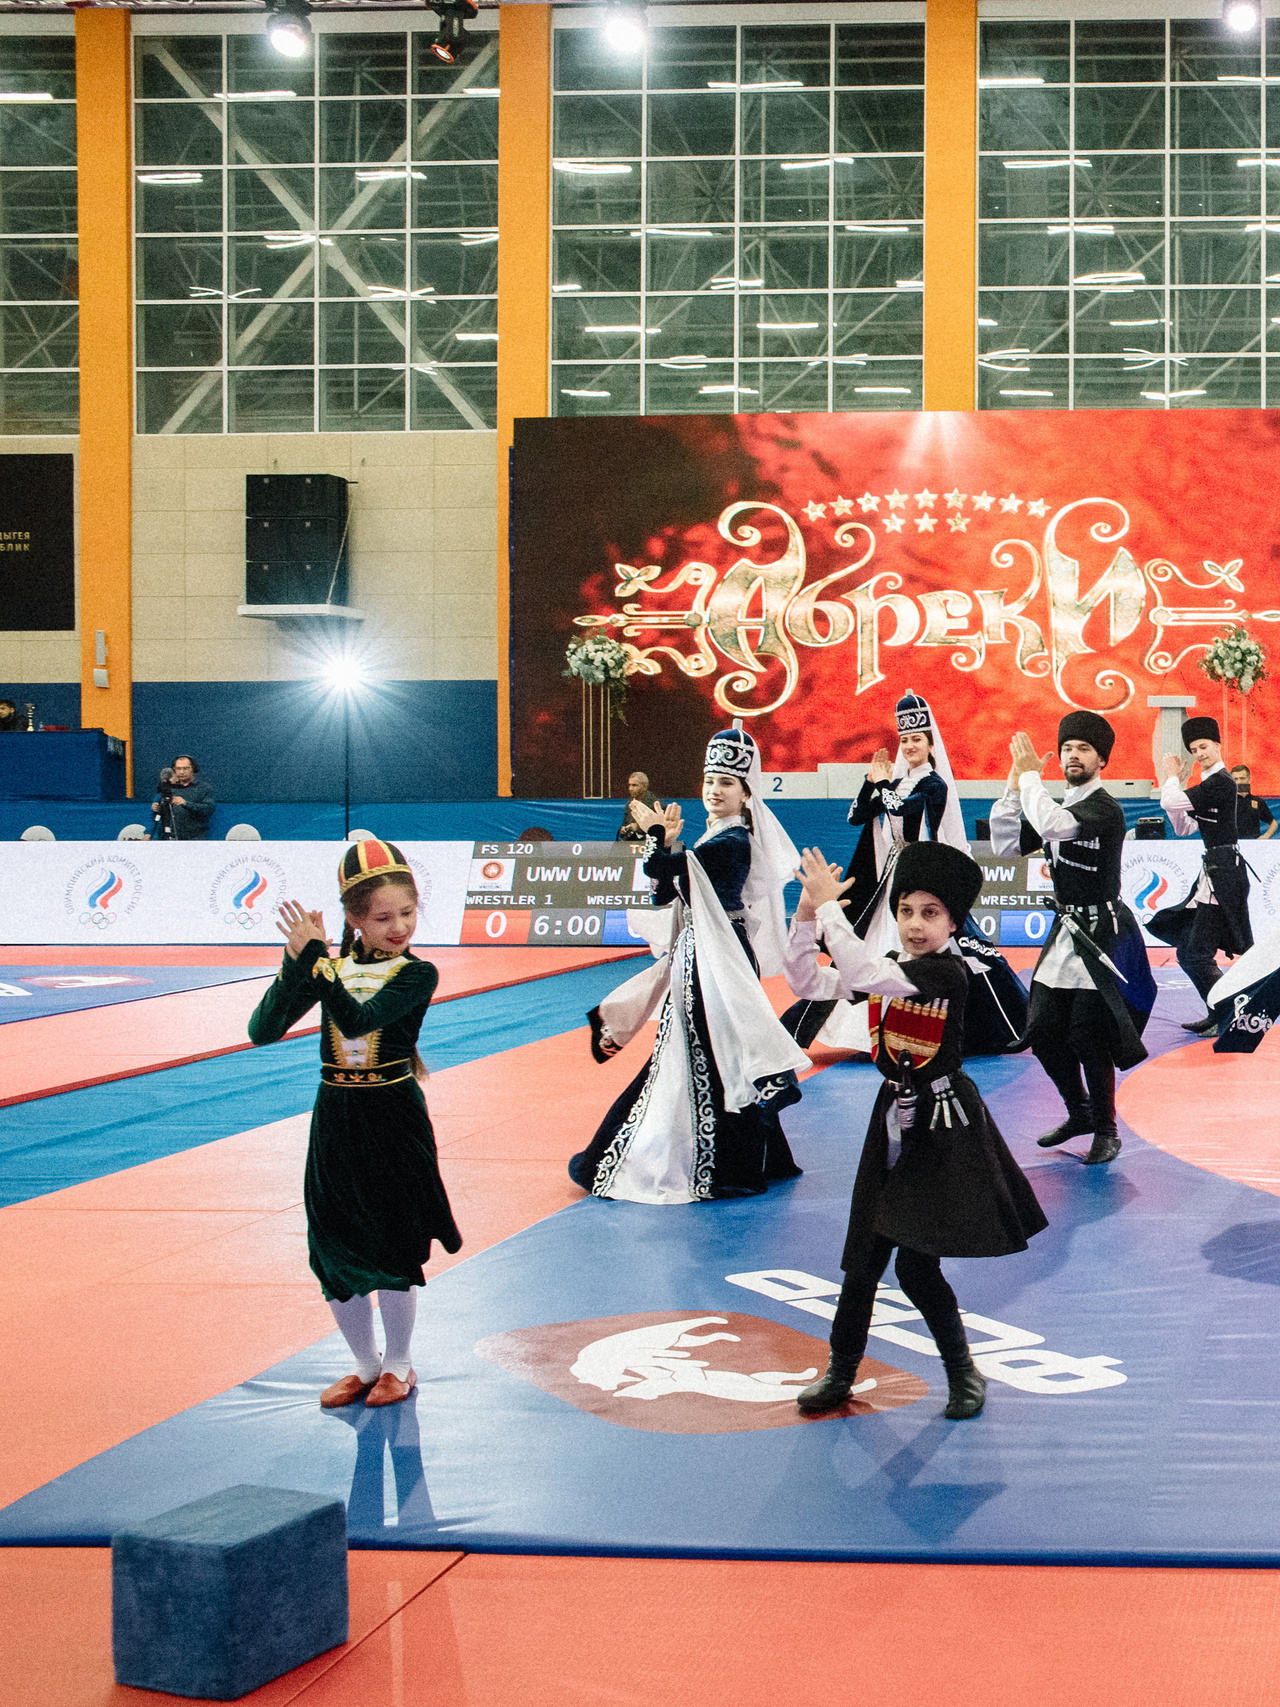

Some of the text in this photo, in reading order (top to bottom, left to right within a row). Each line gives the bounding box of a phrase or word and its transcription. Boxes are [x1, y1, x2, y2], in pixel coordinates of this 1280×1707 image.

[772, 776, 783, 792] 2
[481, 843, 534, 855] FS 120
[572, 843, 583, 856] 0
[251, 855, 285, 878] КОМИТЕТ
[525, 866, 623, 882] UWW UWW
[980, 866, 1016, 882] WW
[1146, 854, 1185, 878] КОМИТЕТ
[106, 855, 141, 878] КОМИТЕТ
[124, 878, 143, 915] РОССИИ
[465, 894, 553, 905] WRESTLER 1
[586, 895, 653, 905] WRESTLE
[485, 911, 507, 938] 0
[533, 915, 601, 936] 6:00
[1024, 912, 1046, 939] 0
